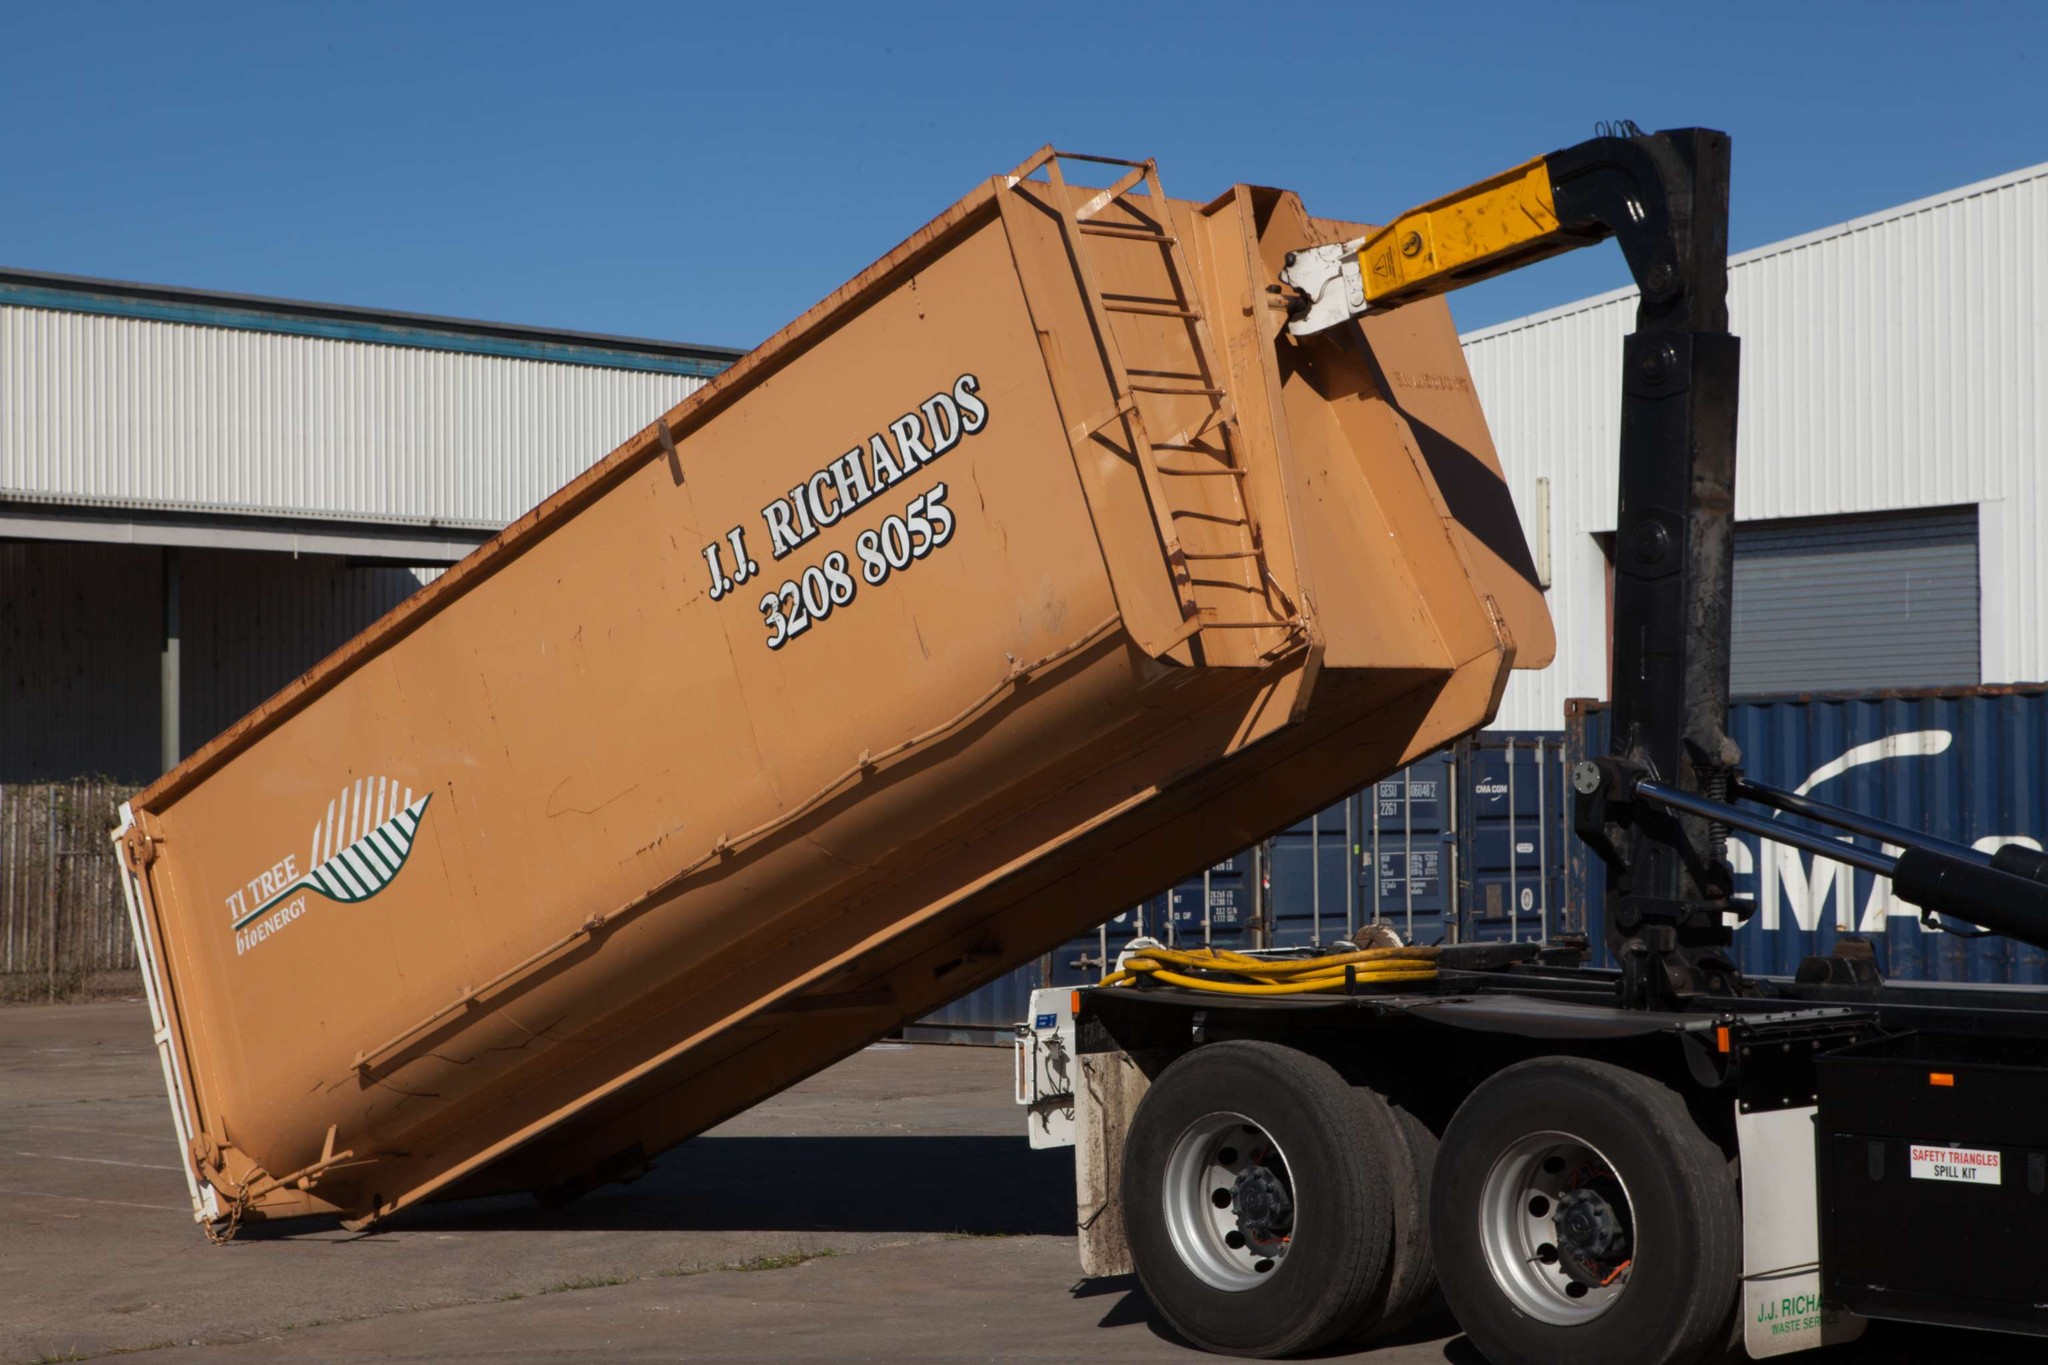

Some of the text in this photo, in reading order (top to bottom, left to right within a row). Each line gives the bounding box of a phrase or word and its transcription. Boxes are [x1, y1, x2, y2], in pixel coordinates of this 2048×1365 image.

[702, 373, 989, 600] J.J. RICHARDS
[759, 482, 956, 650] 3208 8055
[1475, 784, 1508, 793] CMA CGM
[225, 853, 300, 921] TI TREE
[235, 896, 307, 956] bioENERGY
[1912, 1149, 1999, 1167] SAFETY TRIANGLES
[1934, 1165, 1977, 1179] SPILL KIT
[1757, 1301, 1778, 1322] J.J.
[1771, 1319, 1801, 1335] WASTE
